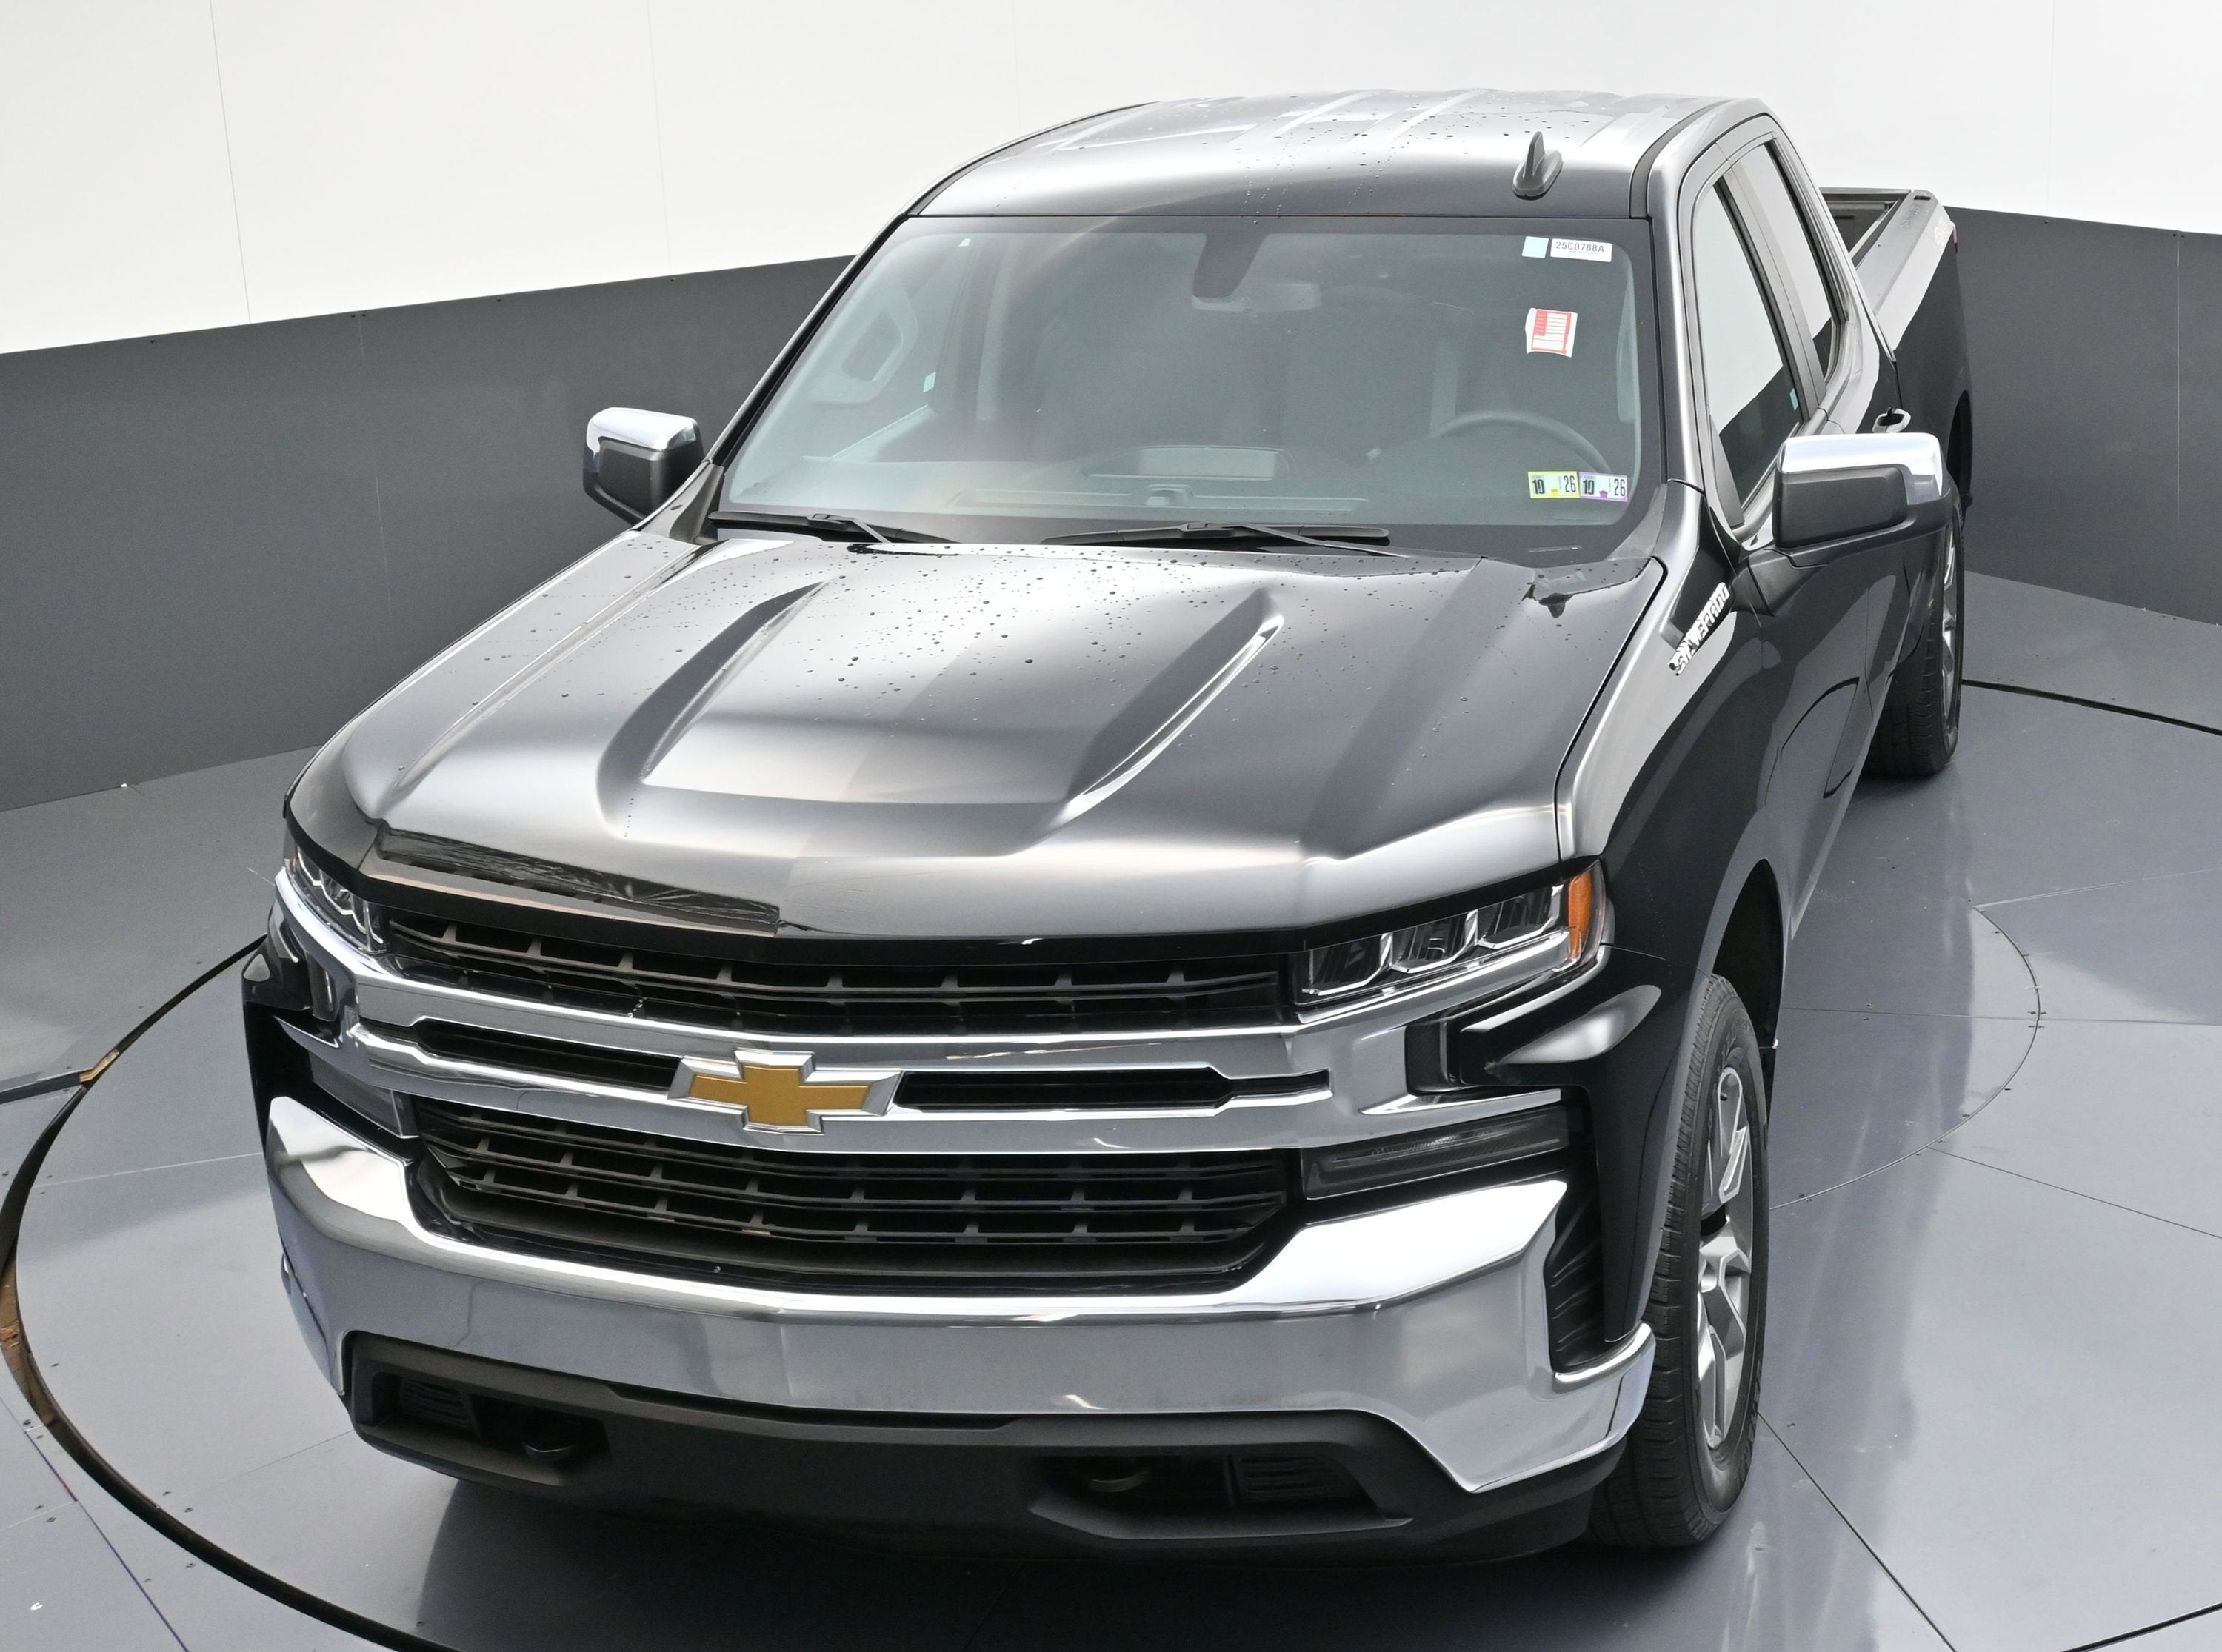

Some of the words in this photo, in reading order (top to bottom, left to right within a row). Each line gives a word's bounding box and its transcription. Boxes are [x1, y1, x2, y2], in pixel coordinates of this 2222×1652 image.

[1555, 241, 1605, 253] 25C0788A
[1532, 478, 1546, 495] 10
[1563, 475, 1577, 493] 26
[1582, 479, 1595, 495] 10
[1613, 478, 1626, 497] 26
